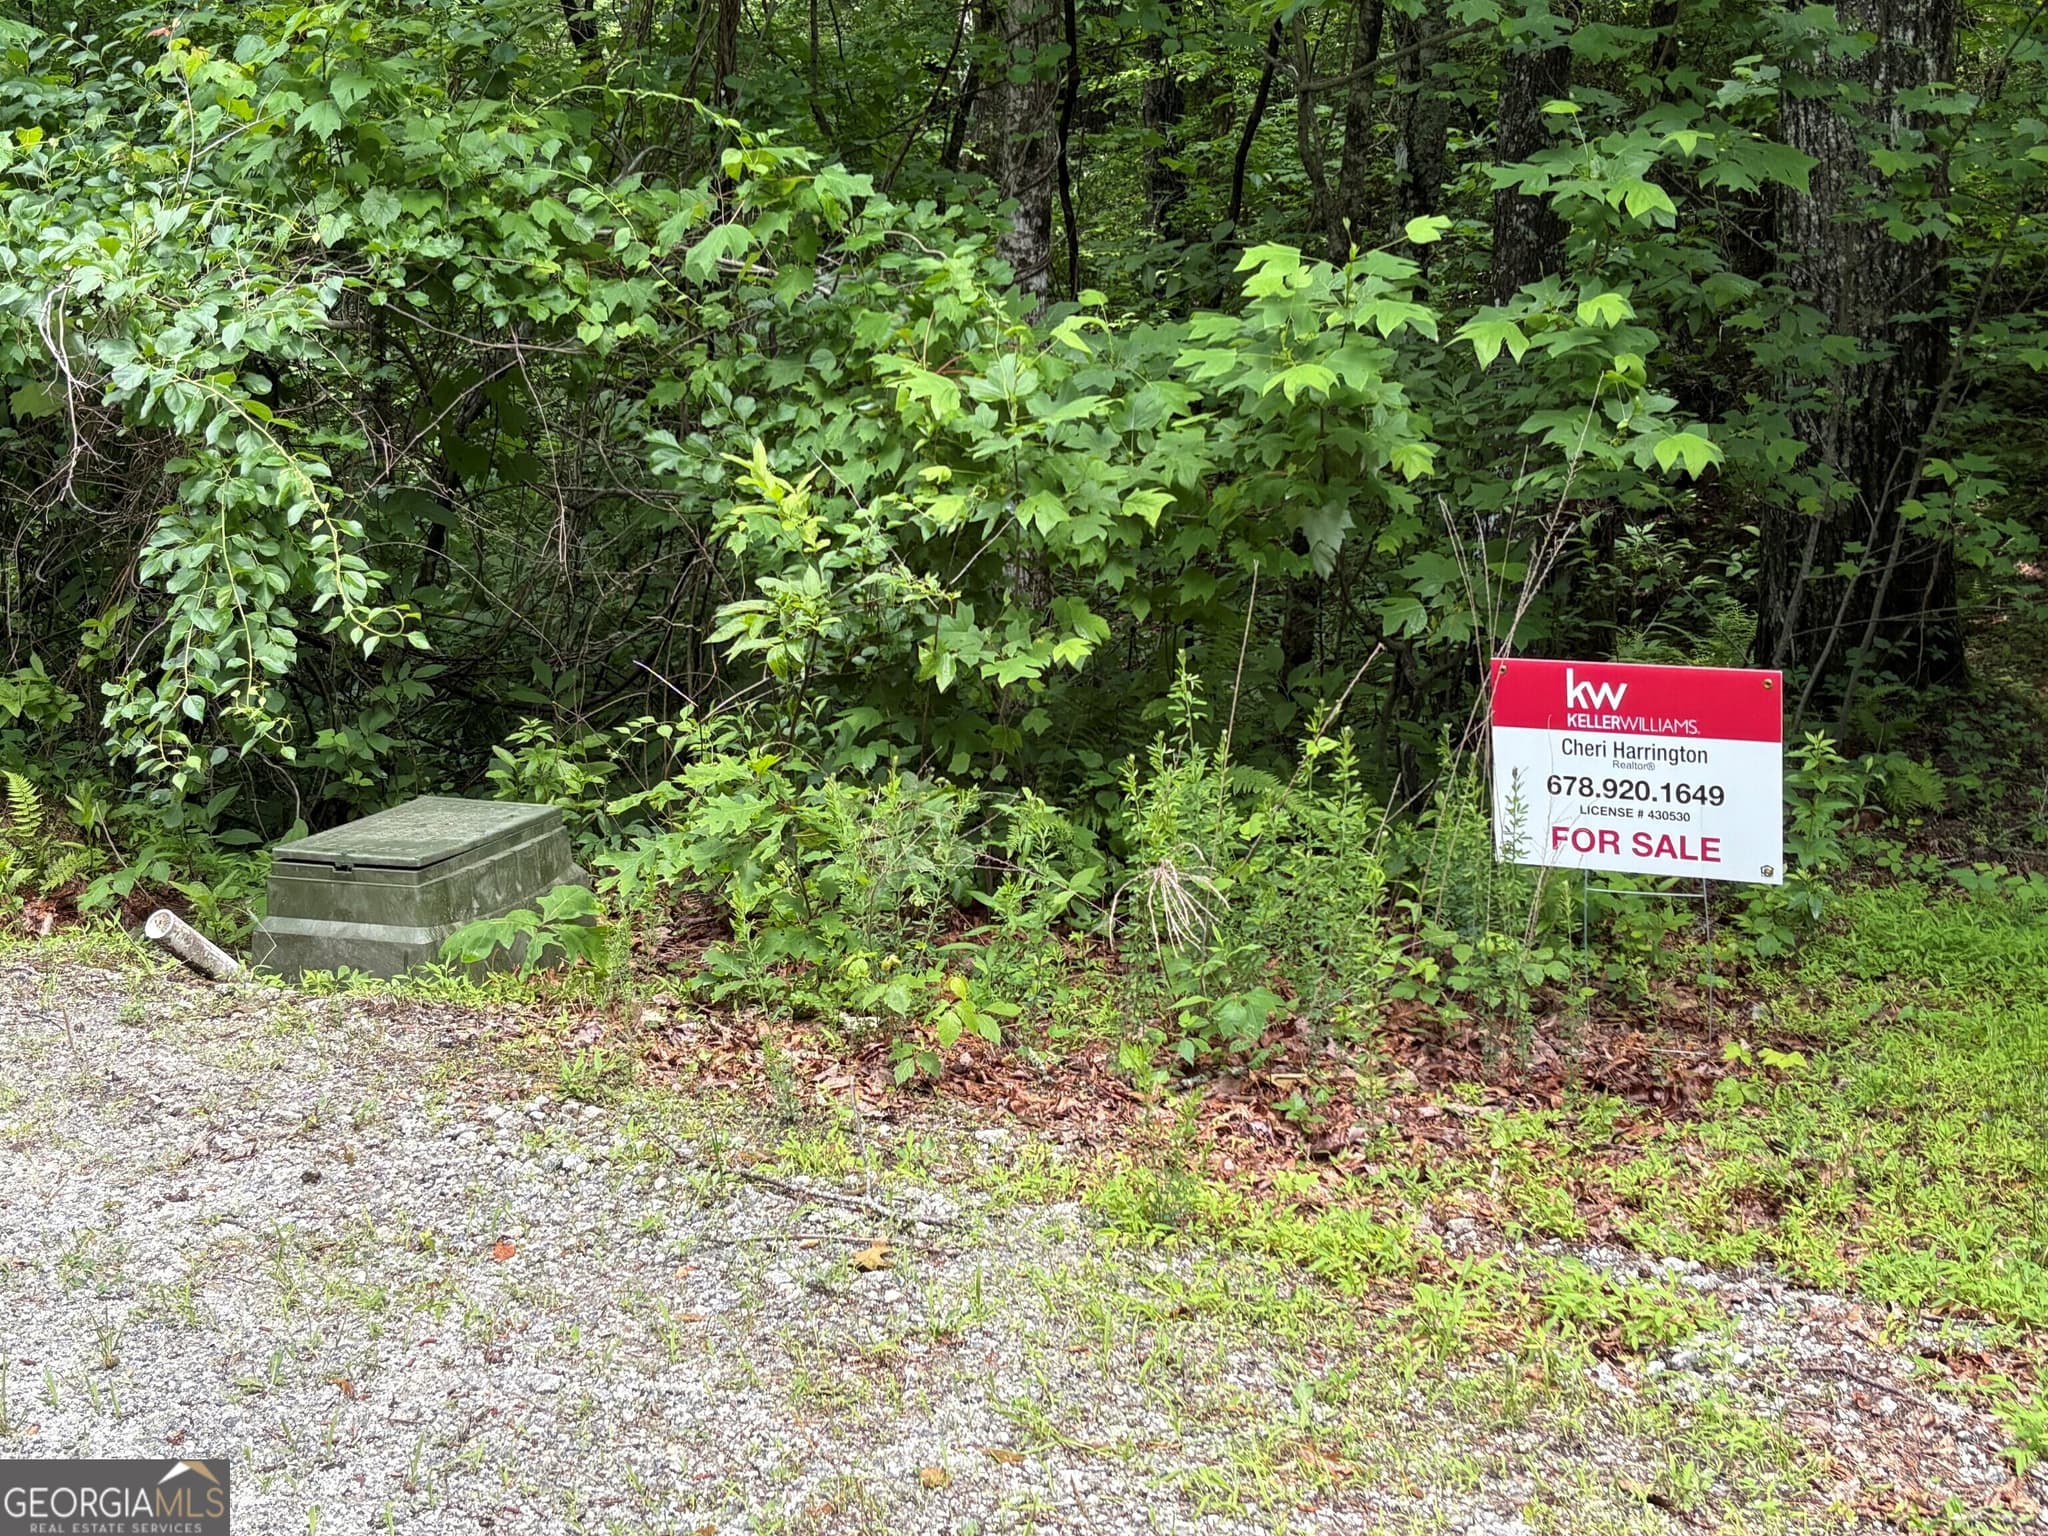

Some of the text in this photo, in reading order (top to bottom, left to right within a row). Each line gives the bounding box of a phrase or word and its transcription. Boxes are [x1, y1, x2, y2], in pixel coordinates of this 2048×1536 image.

[1566, 668, 1628, 710] kw
[1561, 738, 1709, 766] Cheri Harrington
[1546, 775, 1725, 806] 678.920.1649
[1579, 805, 1691, 823] LICENSE # 430530
[1551, 826, 1722, 863] FOR SALE
